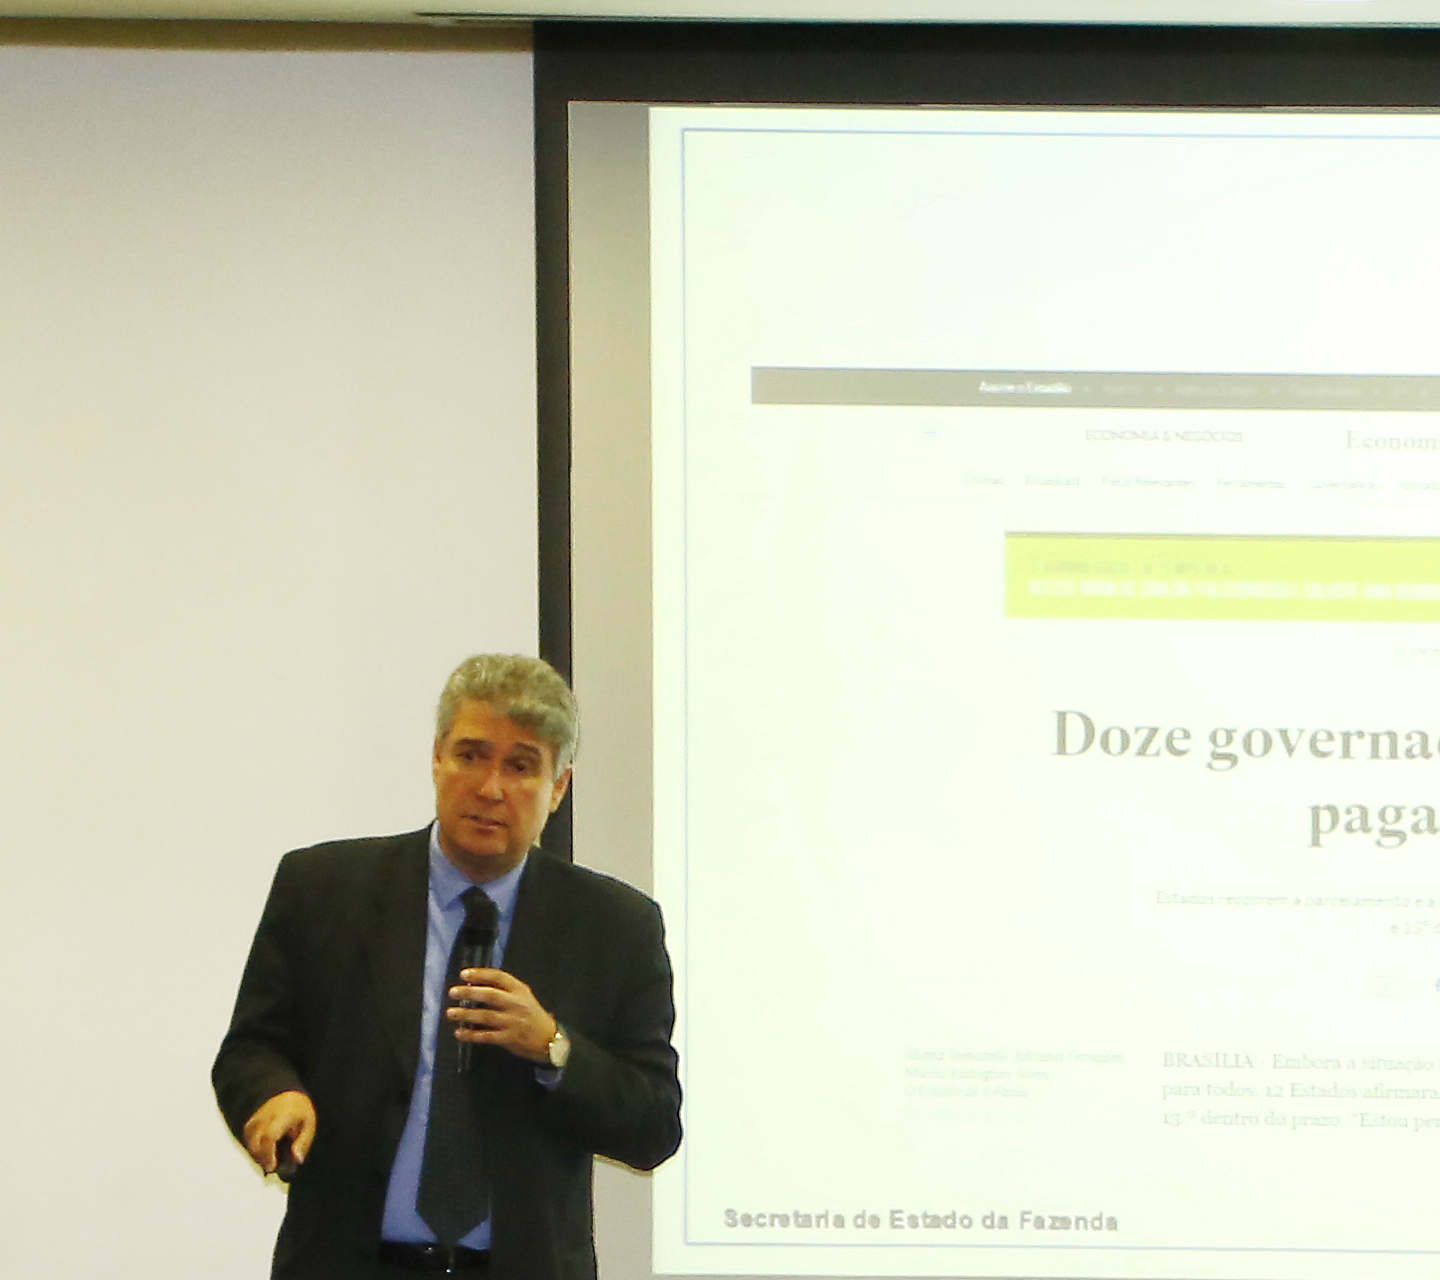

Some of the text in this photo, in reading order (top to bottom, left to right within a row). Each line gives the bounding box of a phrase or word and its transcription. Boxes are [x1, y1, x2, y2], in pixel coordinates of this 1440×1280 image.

[1052, 709, 1192, 758] Doze
[1163, 1051, 1255, 1069] BRASÍLIA
[1272, 1052, 1342, 1070] Embora
[1162, 1083, 1201, 1101] para
[1289, 1082, 1358, 1099] Estados
[1201, 1109, 1260, 1127] dentro
[1264, 1110, 1287, 1127] do
[722, 1208, 1119, 1232] Secretaria de Estado da Fazenda
